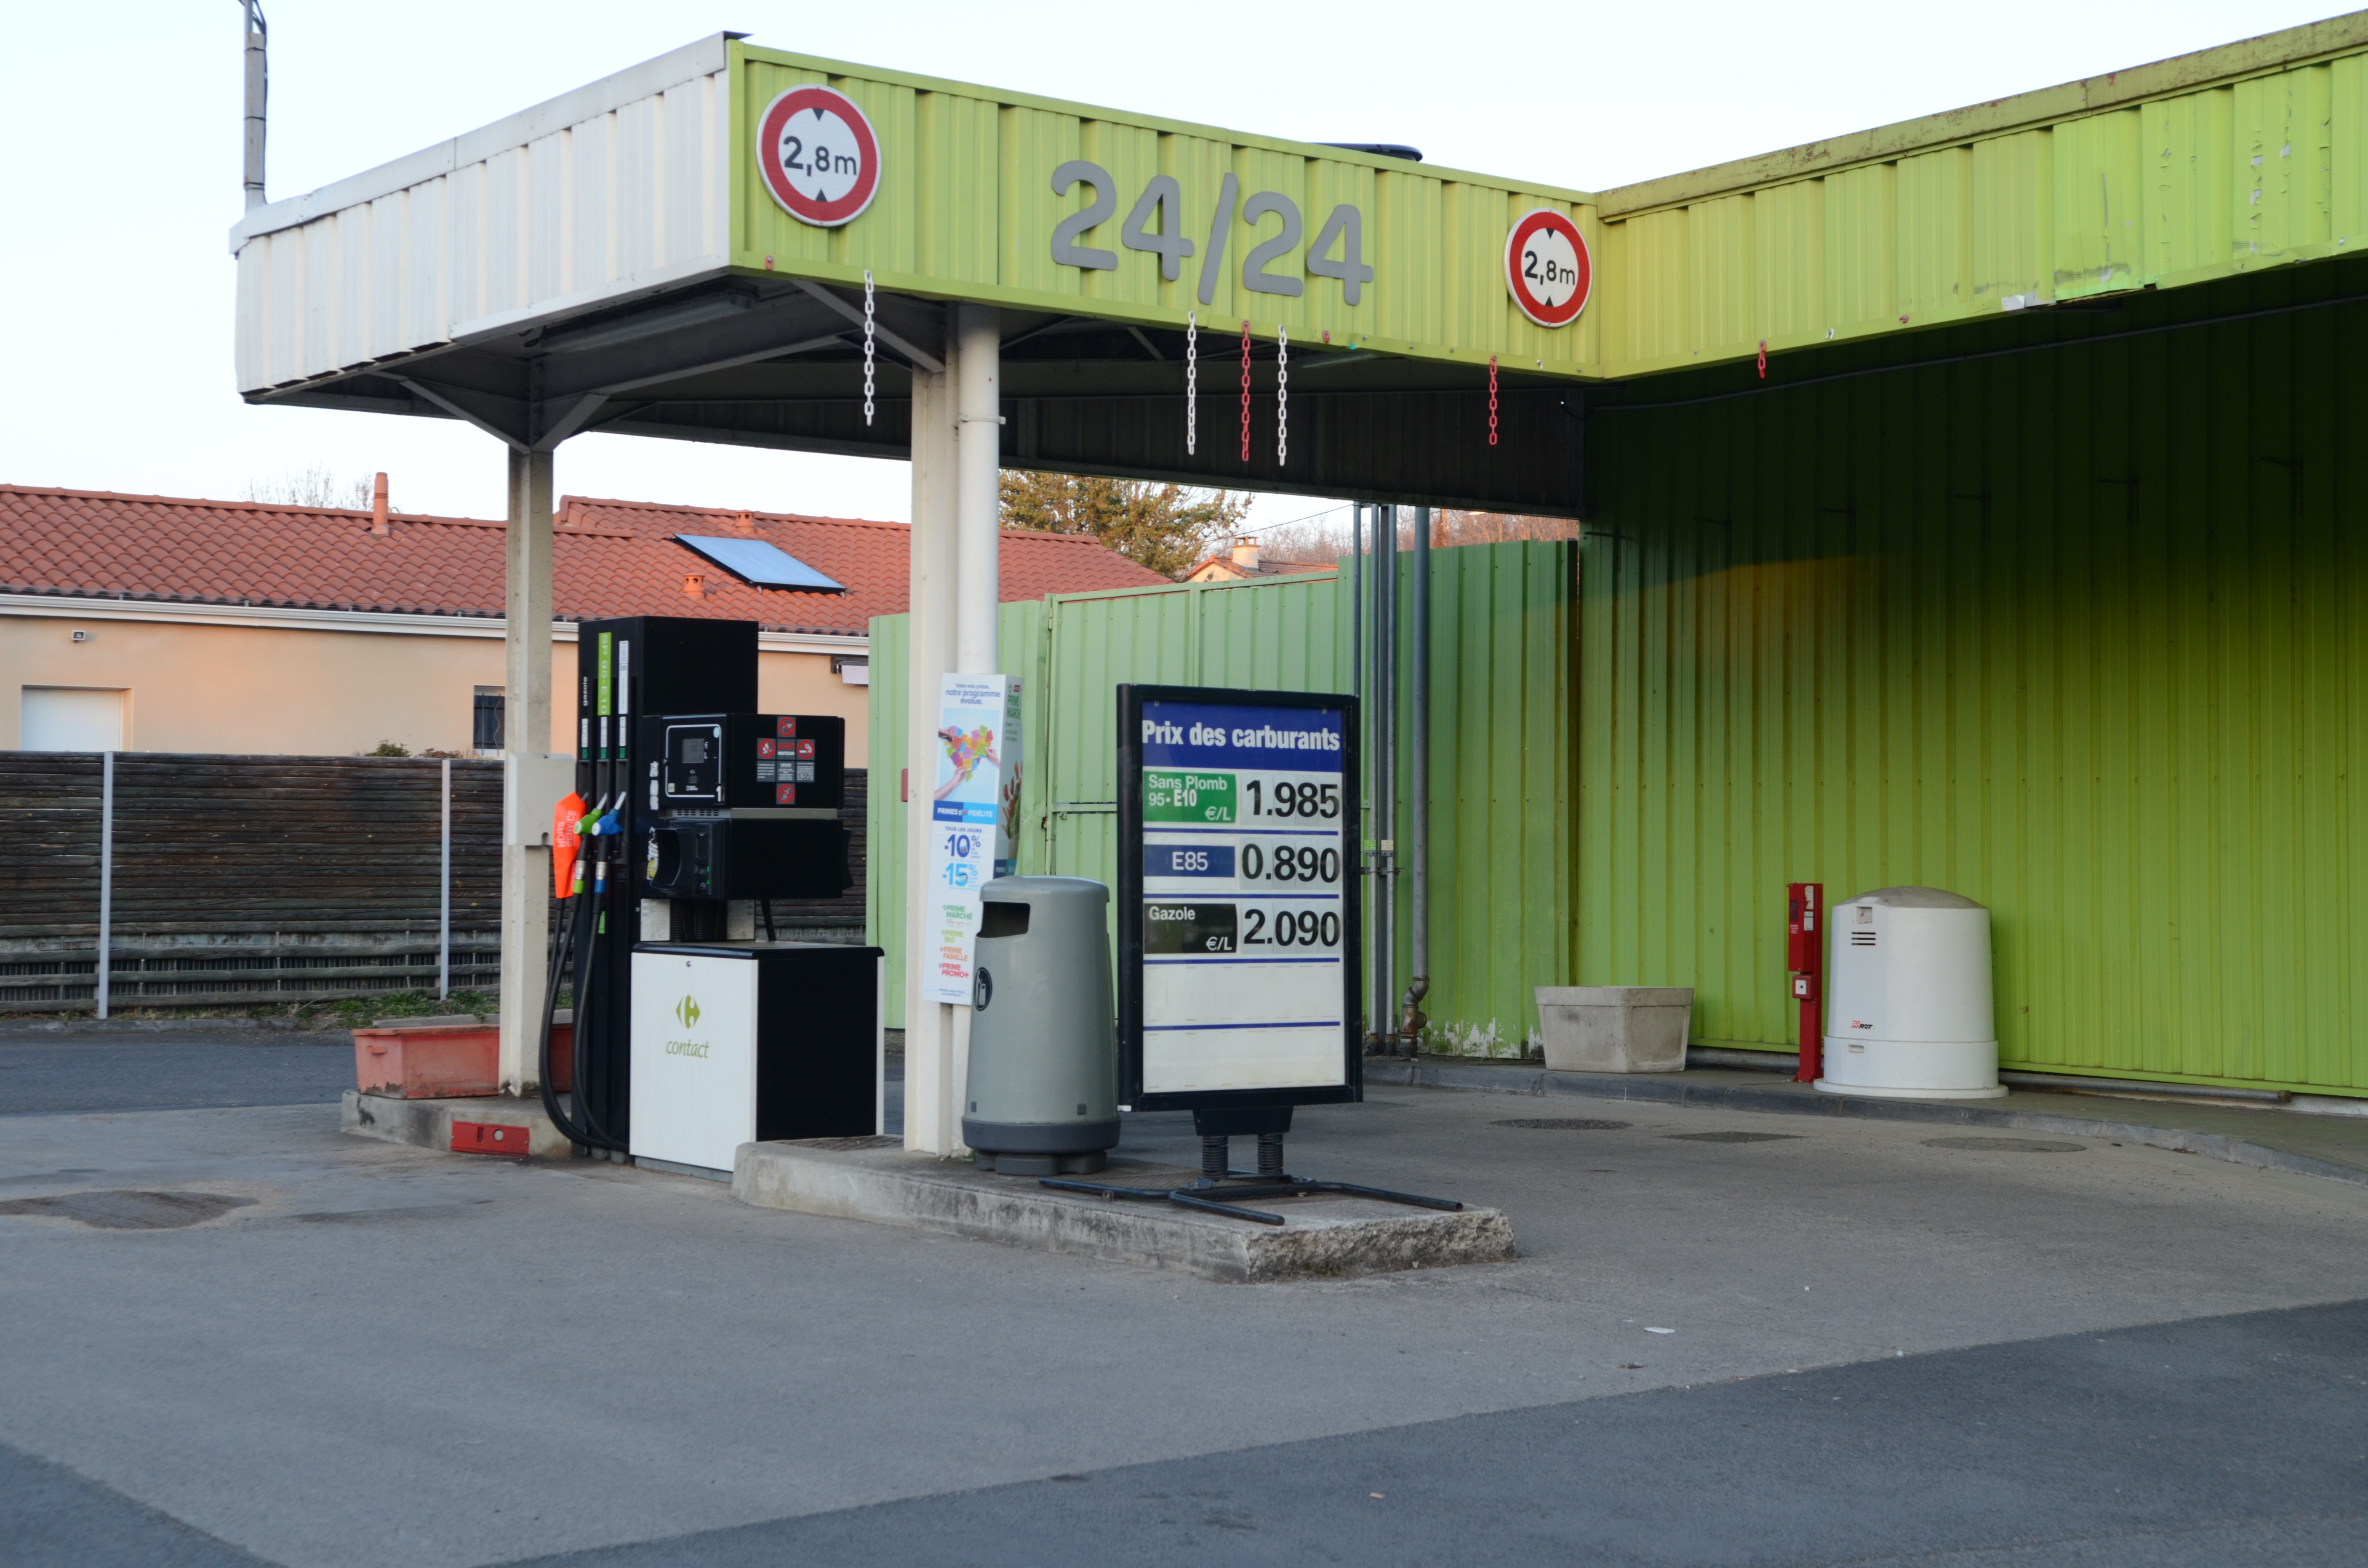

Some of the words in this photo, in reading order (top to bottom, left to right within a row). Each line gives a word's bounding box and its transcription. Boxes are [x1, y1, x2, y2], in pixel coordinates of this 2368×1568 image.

[1051, 160, 1373, 306] 24/24
[1142, 720, 1184, 745] Prix
[1189, 722, 1226, 747] des
[1232, 725, 1340, 751] carburants
[1148, 774, 1182, 789] Sans
[1185, 775, 1227, 790] Plomb
[1246, 780, 1340, 819] 1.985
[1205, 806, 1231, 821] €/L
[556, 821, 565, 847] HORS
[566, 810, 576, 847] SERVICE
[1172, 852, 1208, 870] E85
[1242, 844, 1340, 883] 0.890
[946, 911, 973, 919] MARCHÉ
[1149, 906, 1196, 920] Gazole
[1244, 909, 1340, 947] 2.090
[943, 946, 962, 954] PRIME
[1206, 936, 1232, 951] €/L
[943, 953, 968, 961] FAMILLE
[941, 969, 969, 978] PROMO+
[666, 1039, 710, 1058] contact
